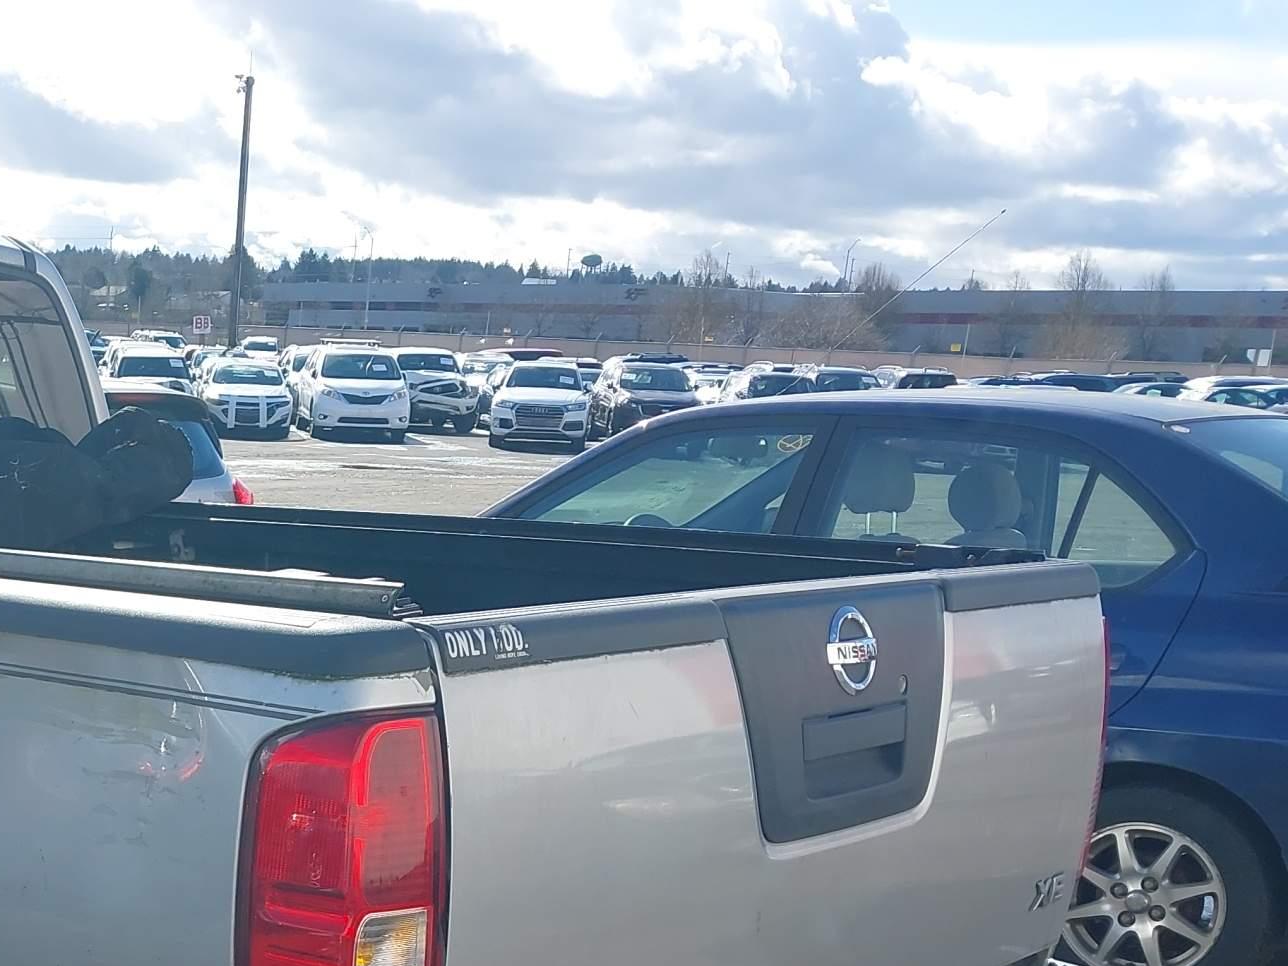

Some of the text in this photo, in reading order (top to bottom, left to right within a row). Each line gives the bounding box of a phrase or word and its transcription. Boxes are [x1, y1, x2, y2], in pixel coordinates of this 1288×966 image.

[445, 628, 487, 658] ONLY
[836, 641, 878, 661] NISSAN
[1028, 871, 1065, 912] XE
